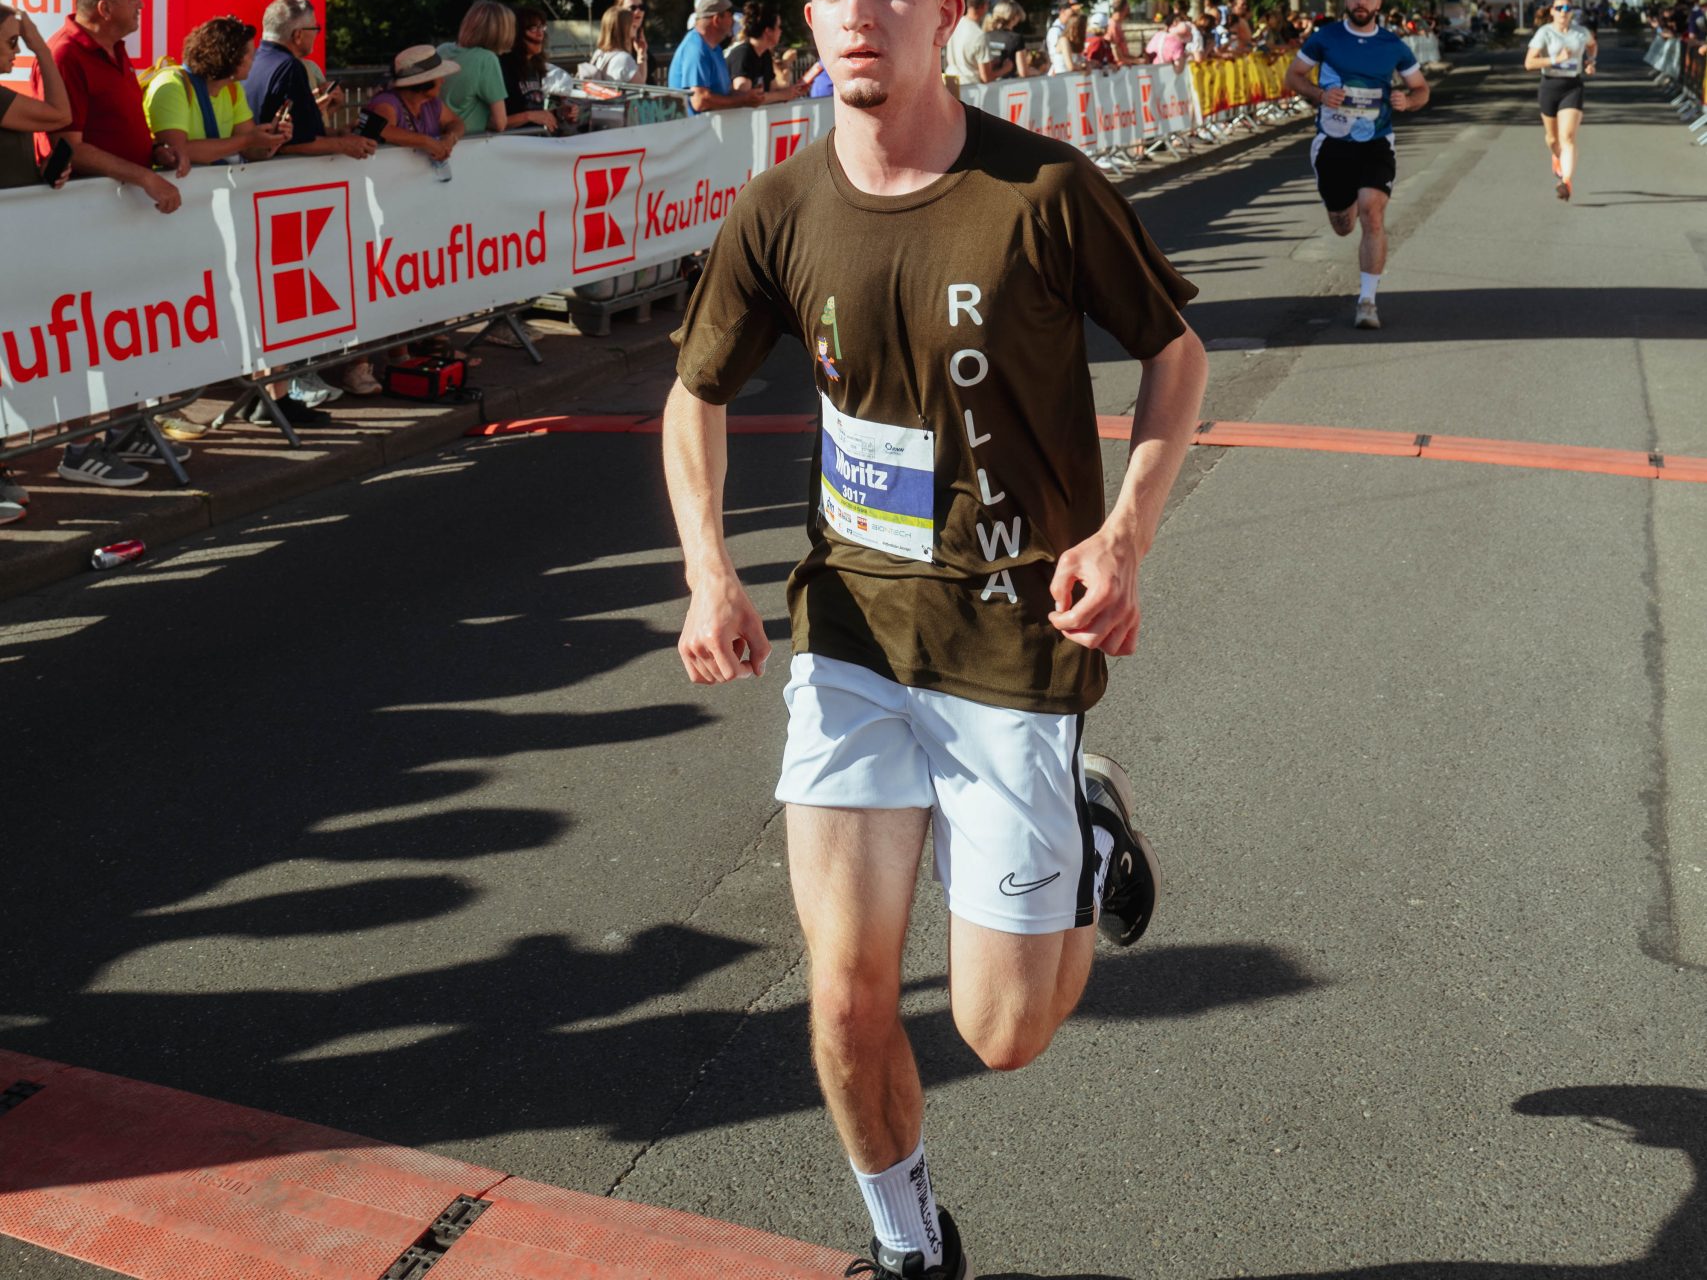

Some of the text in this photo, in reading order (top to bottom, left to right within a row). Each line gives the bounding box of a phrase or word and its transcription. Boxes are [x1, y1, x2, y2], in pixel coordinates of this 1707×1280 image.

[0, 270, 218, 386] ufland
[365, 211, 547, 302] Kaufland
[835, 445, 888, 491] Moritz
[842, 484, 866, 505] 3017
